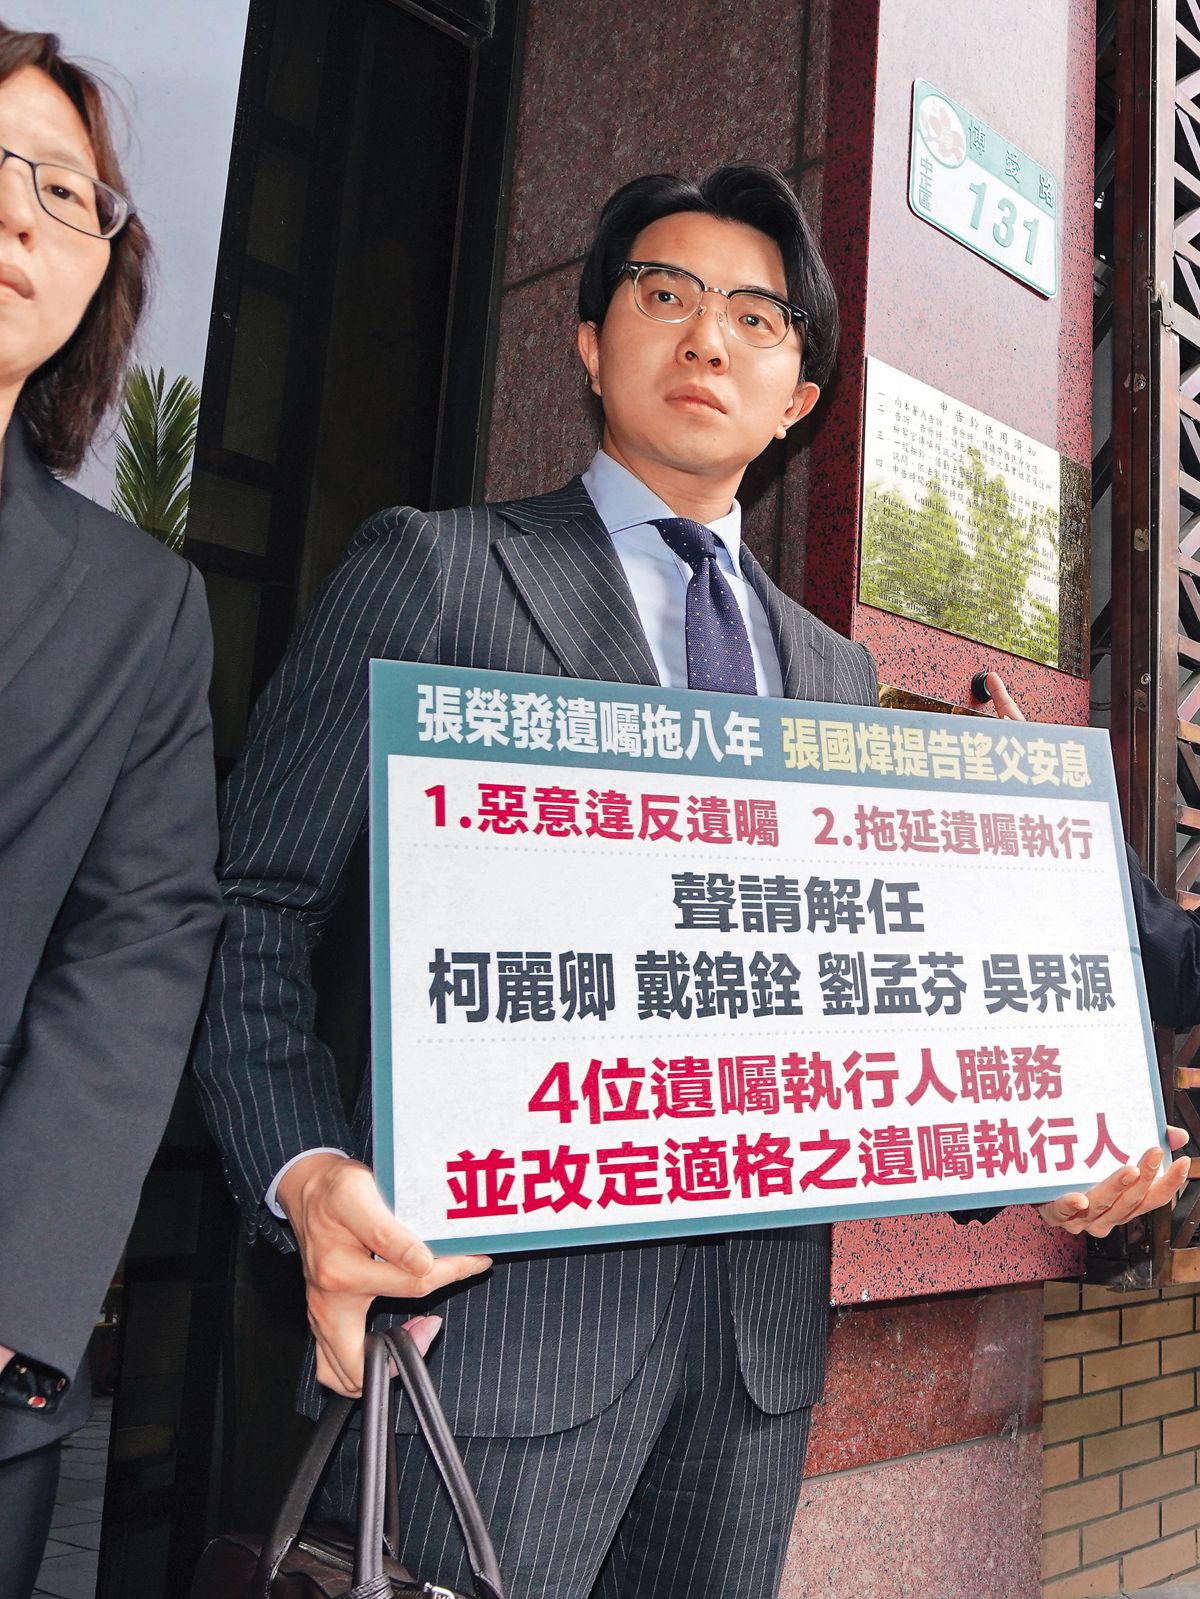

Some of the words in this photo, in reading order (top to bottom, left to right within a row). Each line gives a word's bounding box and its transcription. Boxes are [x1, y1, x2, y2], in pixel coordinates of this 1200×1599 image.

[969, 120, 1053, 208] 博愛路
[968, 181, 1039, 266] 131
[417, 684, 763, 766] 張榮發遺囑拖八年
[781, 716, 1092, 788] 張國煒提告望父安息
[671, 871, 925, 935] 聲請解任
[428, 948, 615, 1024] 柯麗卿
[634, 950, 804, 1020] 戴錦銓
[818, 951, 968, 1016] 劉孟芬
[982, 953, 1116, 1014] 吳界源
[527, 1044, 1063, 1125] 4位遺囑執行人職務
[446, 1112, 1131, 1220] 並改定適格之遺囑執行人
